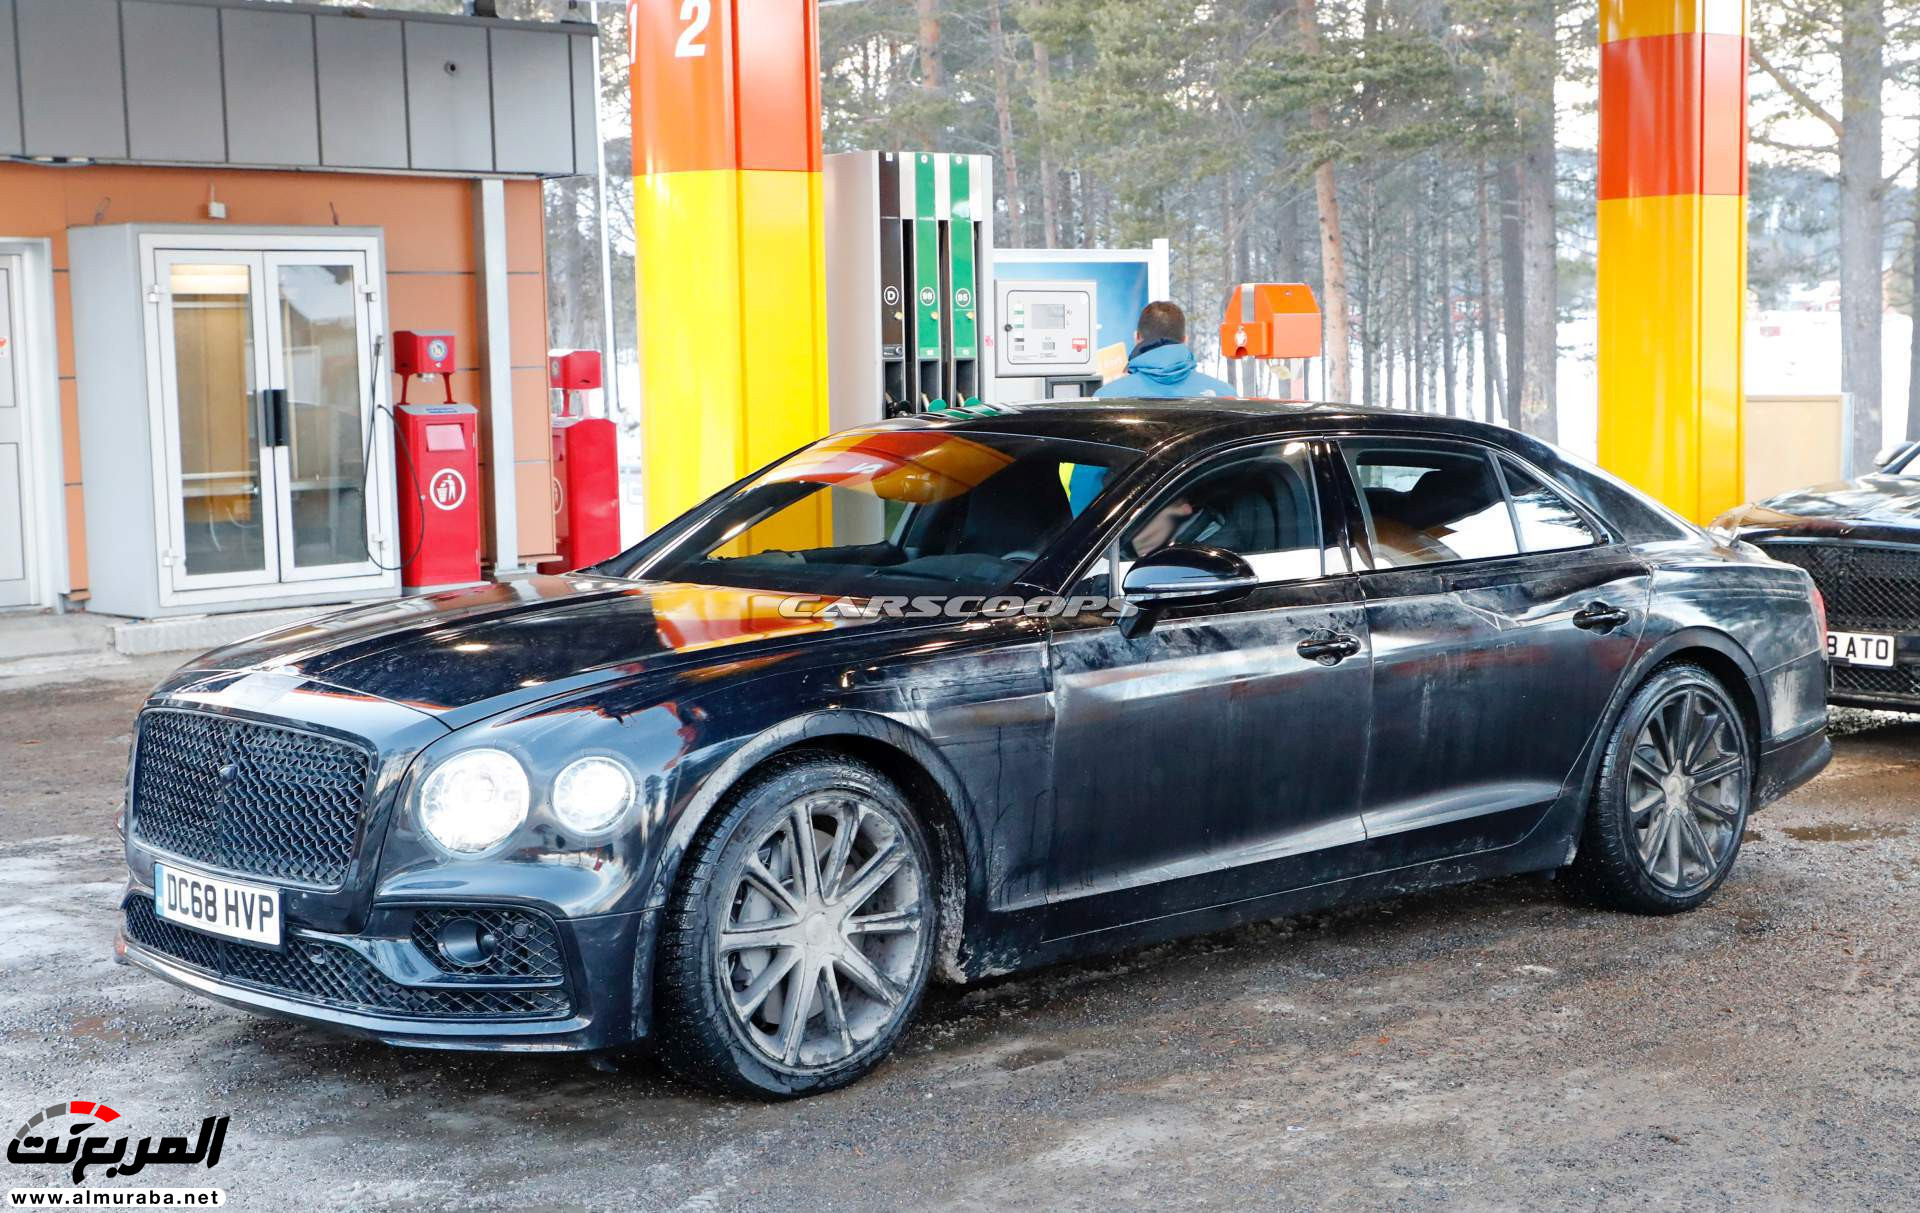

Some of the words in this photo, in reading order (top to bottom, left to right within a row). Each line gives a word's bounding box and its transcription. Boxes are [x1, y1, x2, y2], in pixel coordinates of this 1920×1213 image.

[674, 0, 711, 57] 2
[1845, 636, 1889, 660] ATO
[167, 873, 217, 922] DC68
[224, 888, 274, 933] HVP
